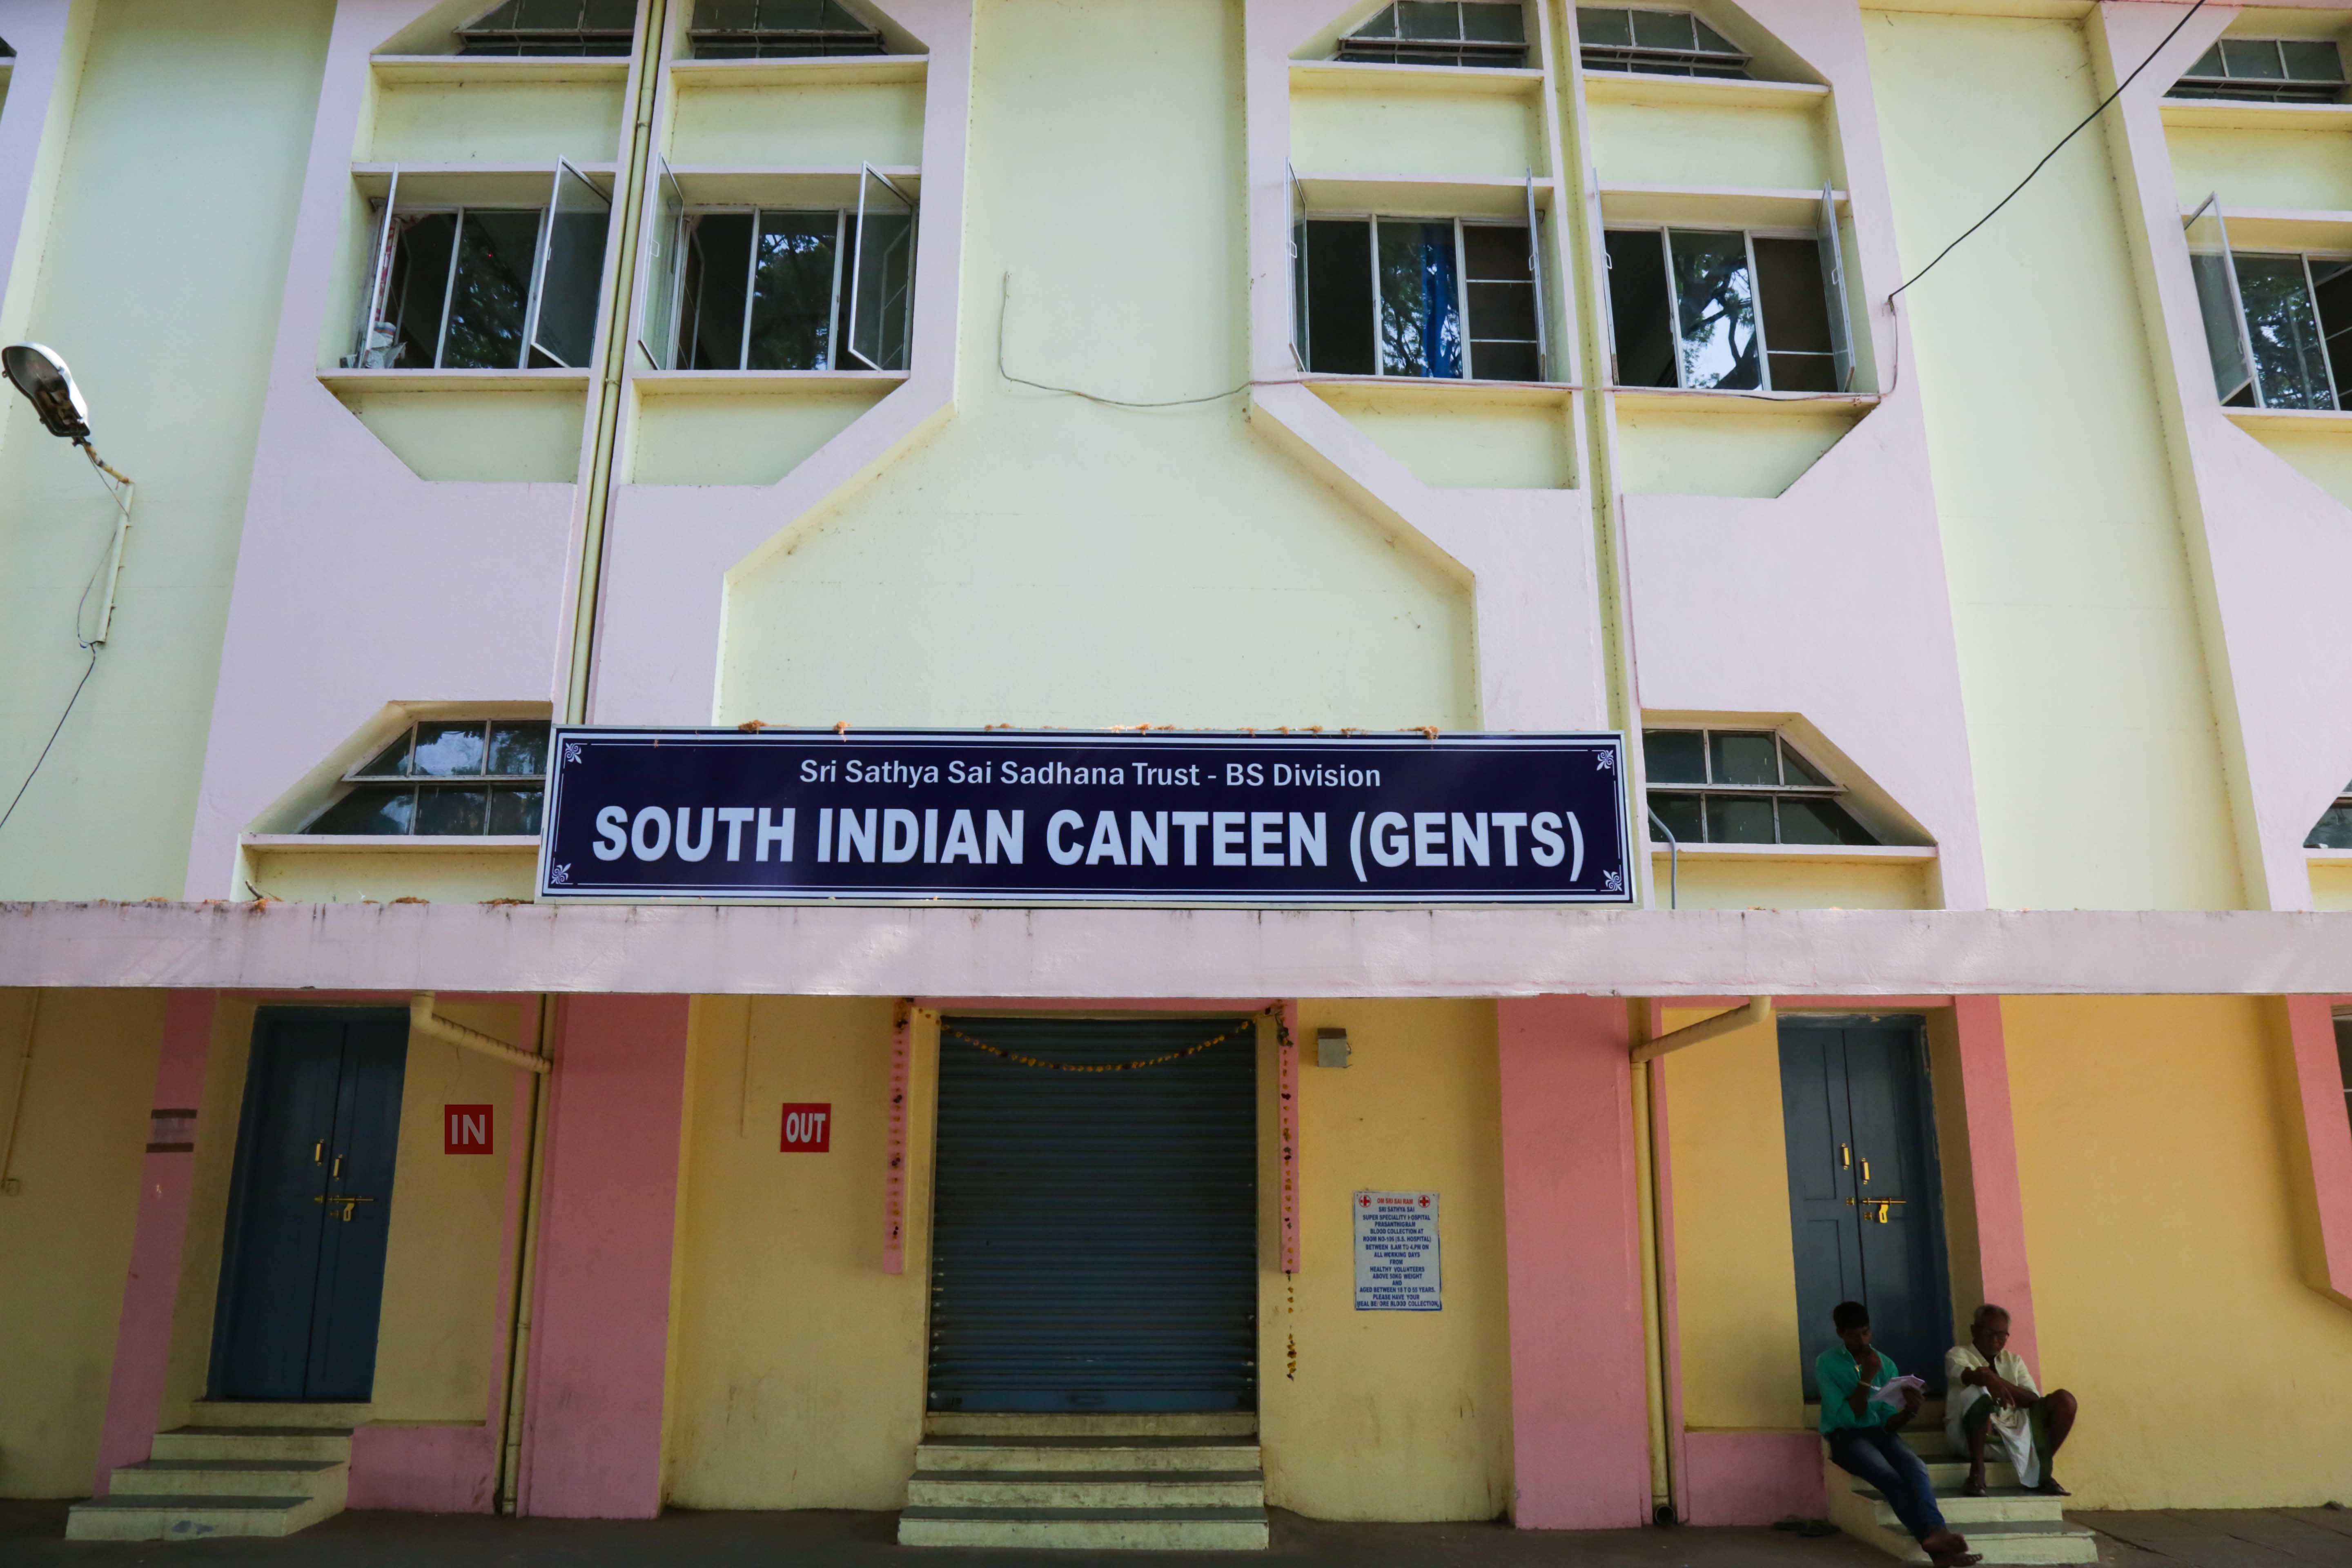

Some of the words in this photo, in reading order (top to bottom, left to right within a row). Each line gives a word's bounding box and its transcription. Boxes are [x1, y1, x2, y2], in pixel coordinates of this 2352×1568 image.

[800, 760, 836, 782] Sri
[845, 760, 938, 788] Sathya
[948, 760, 991, 784] Sai
[1001, 761, 1124, 785] Sadhana
[1132, 763, 1200, 786] Trust
[1227, 763, 1264, 786] BS
[1274, 764, 1380, 787] Division
[592, 806, 796, 862] SOUTH
[817, 808, 1025, 864] INDIAN
[1046, 810, 1327, 866] CANTEEN
[1350, 811, 1584, 882] (GENTS)
[452, 1114, 485, 1144] IN
[786, 1112, 826, 1143] OUT
